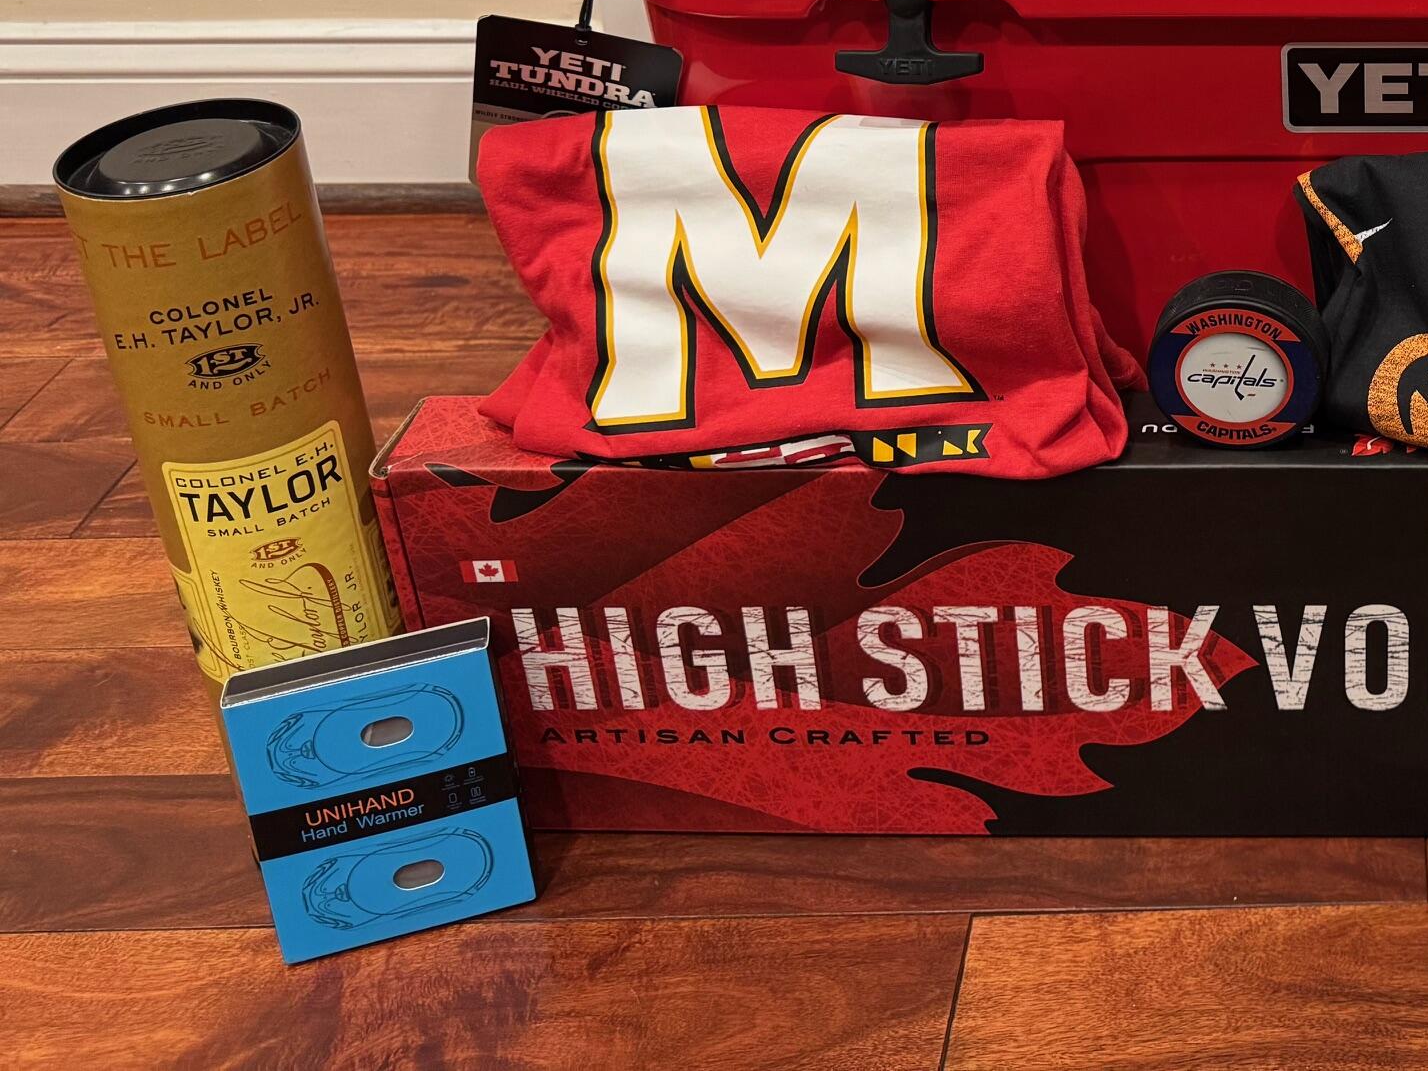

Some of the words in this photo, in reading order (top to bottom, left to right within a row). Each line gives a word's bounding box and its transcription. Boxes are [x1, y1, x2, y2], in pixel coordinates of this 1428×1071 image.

[490, 59, 657, 108] TUNDRA
[530, 46, 624, 81] YETI
[490, 78, 529, 92] HAUL
[531, 85, 600, 107] WHEELED
[102, 243, 176, 270] THE
[198, 201, 303, 261] LABEL
[585, 105, 989, 433] M
[114, 332, 156, 350] E.H.
[161, 307, 282, 345] TAYLOR,
[288, 292, 320, 315] JR.
[149, 288, 273, 325] COLONEL
[1185, 313, 1282, 341] WASHINGTON
[187, 378, 223, 391] AND
[232, 359, 273, 386] ONLY
[143, 411, 229, 428] SMALL
[250, 368, 331, 417] BATCH
[1196, 420, 1272, 441] CAPITALS
[175, 464, 287, 489] COLONEL
[295, 441, 335, 467] E.H.
[179, 454, 343, 523] TAYLOR
[207, 524, 264, 538] SMALL
[276, 497, 332, 527] BATCH
[250, 561, 275, 570] AND
[280, 548, 308, 566] ONLY
[223, 615, 242, 660] BOURBON
[510, 606, 821, 712] HIGH
[859, 605, 1229, 713] STICK
[540, 728, 747, 746] ARTISAN
[768, 727, 992, 747] CRAFTED
[301, 821, 348, 843] Hand
[356, 802, 425, 830] Warmer
[305, 788, 416, 828] UNIHAND
